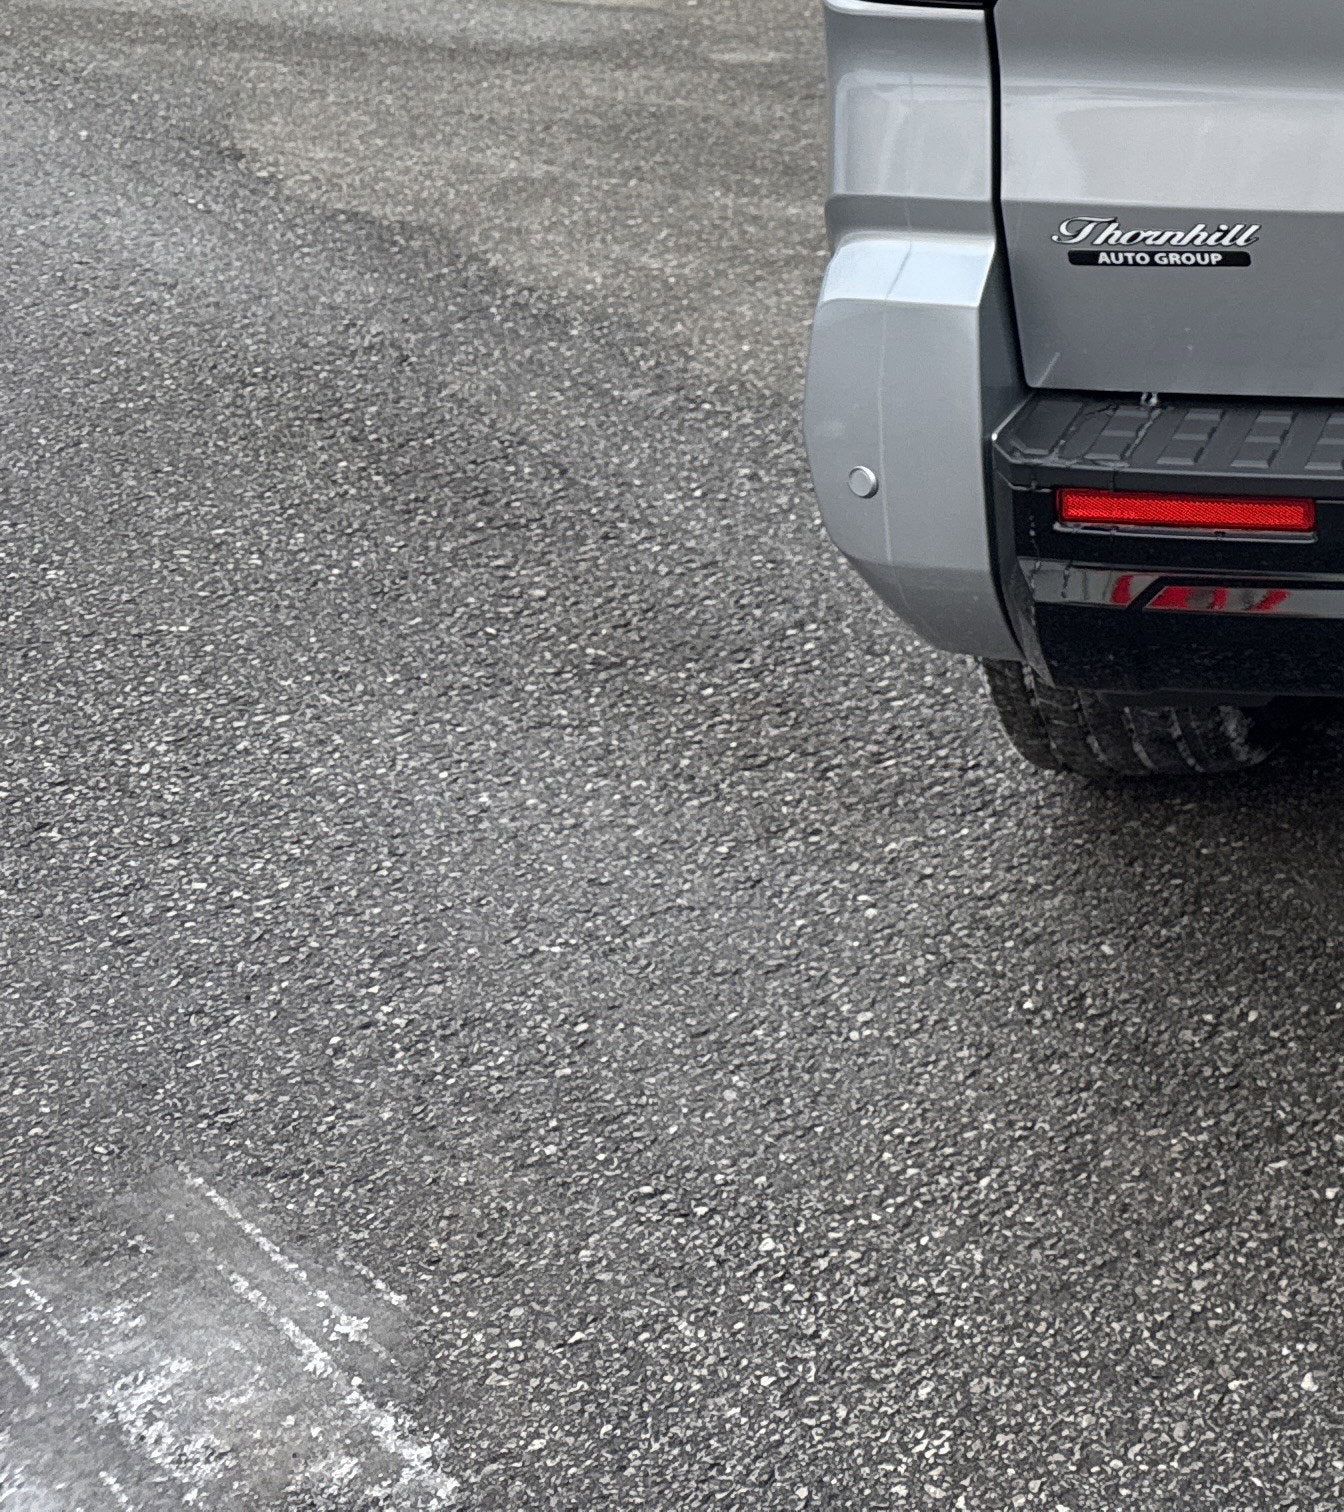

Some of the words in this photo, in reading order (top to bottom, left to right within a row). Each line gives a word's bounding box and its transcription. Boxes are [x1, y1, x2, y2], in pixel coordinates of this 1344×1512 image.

[1051, 216, 1261, 247] Thornhill
[1097, 252, 1150, 266] AUTO
[1154, 252, 1223, 266] GROUP
